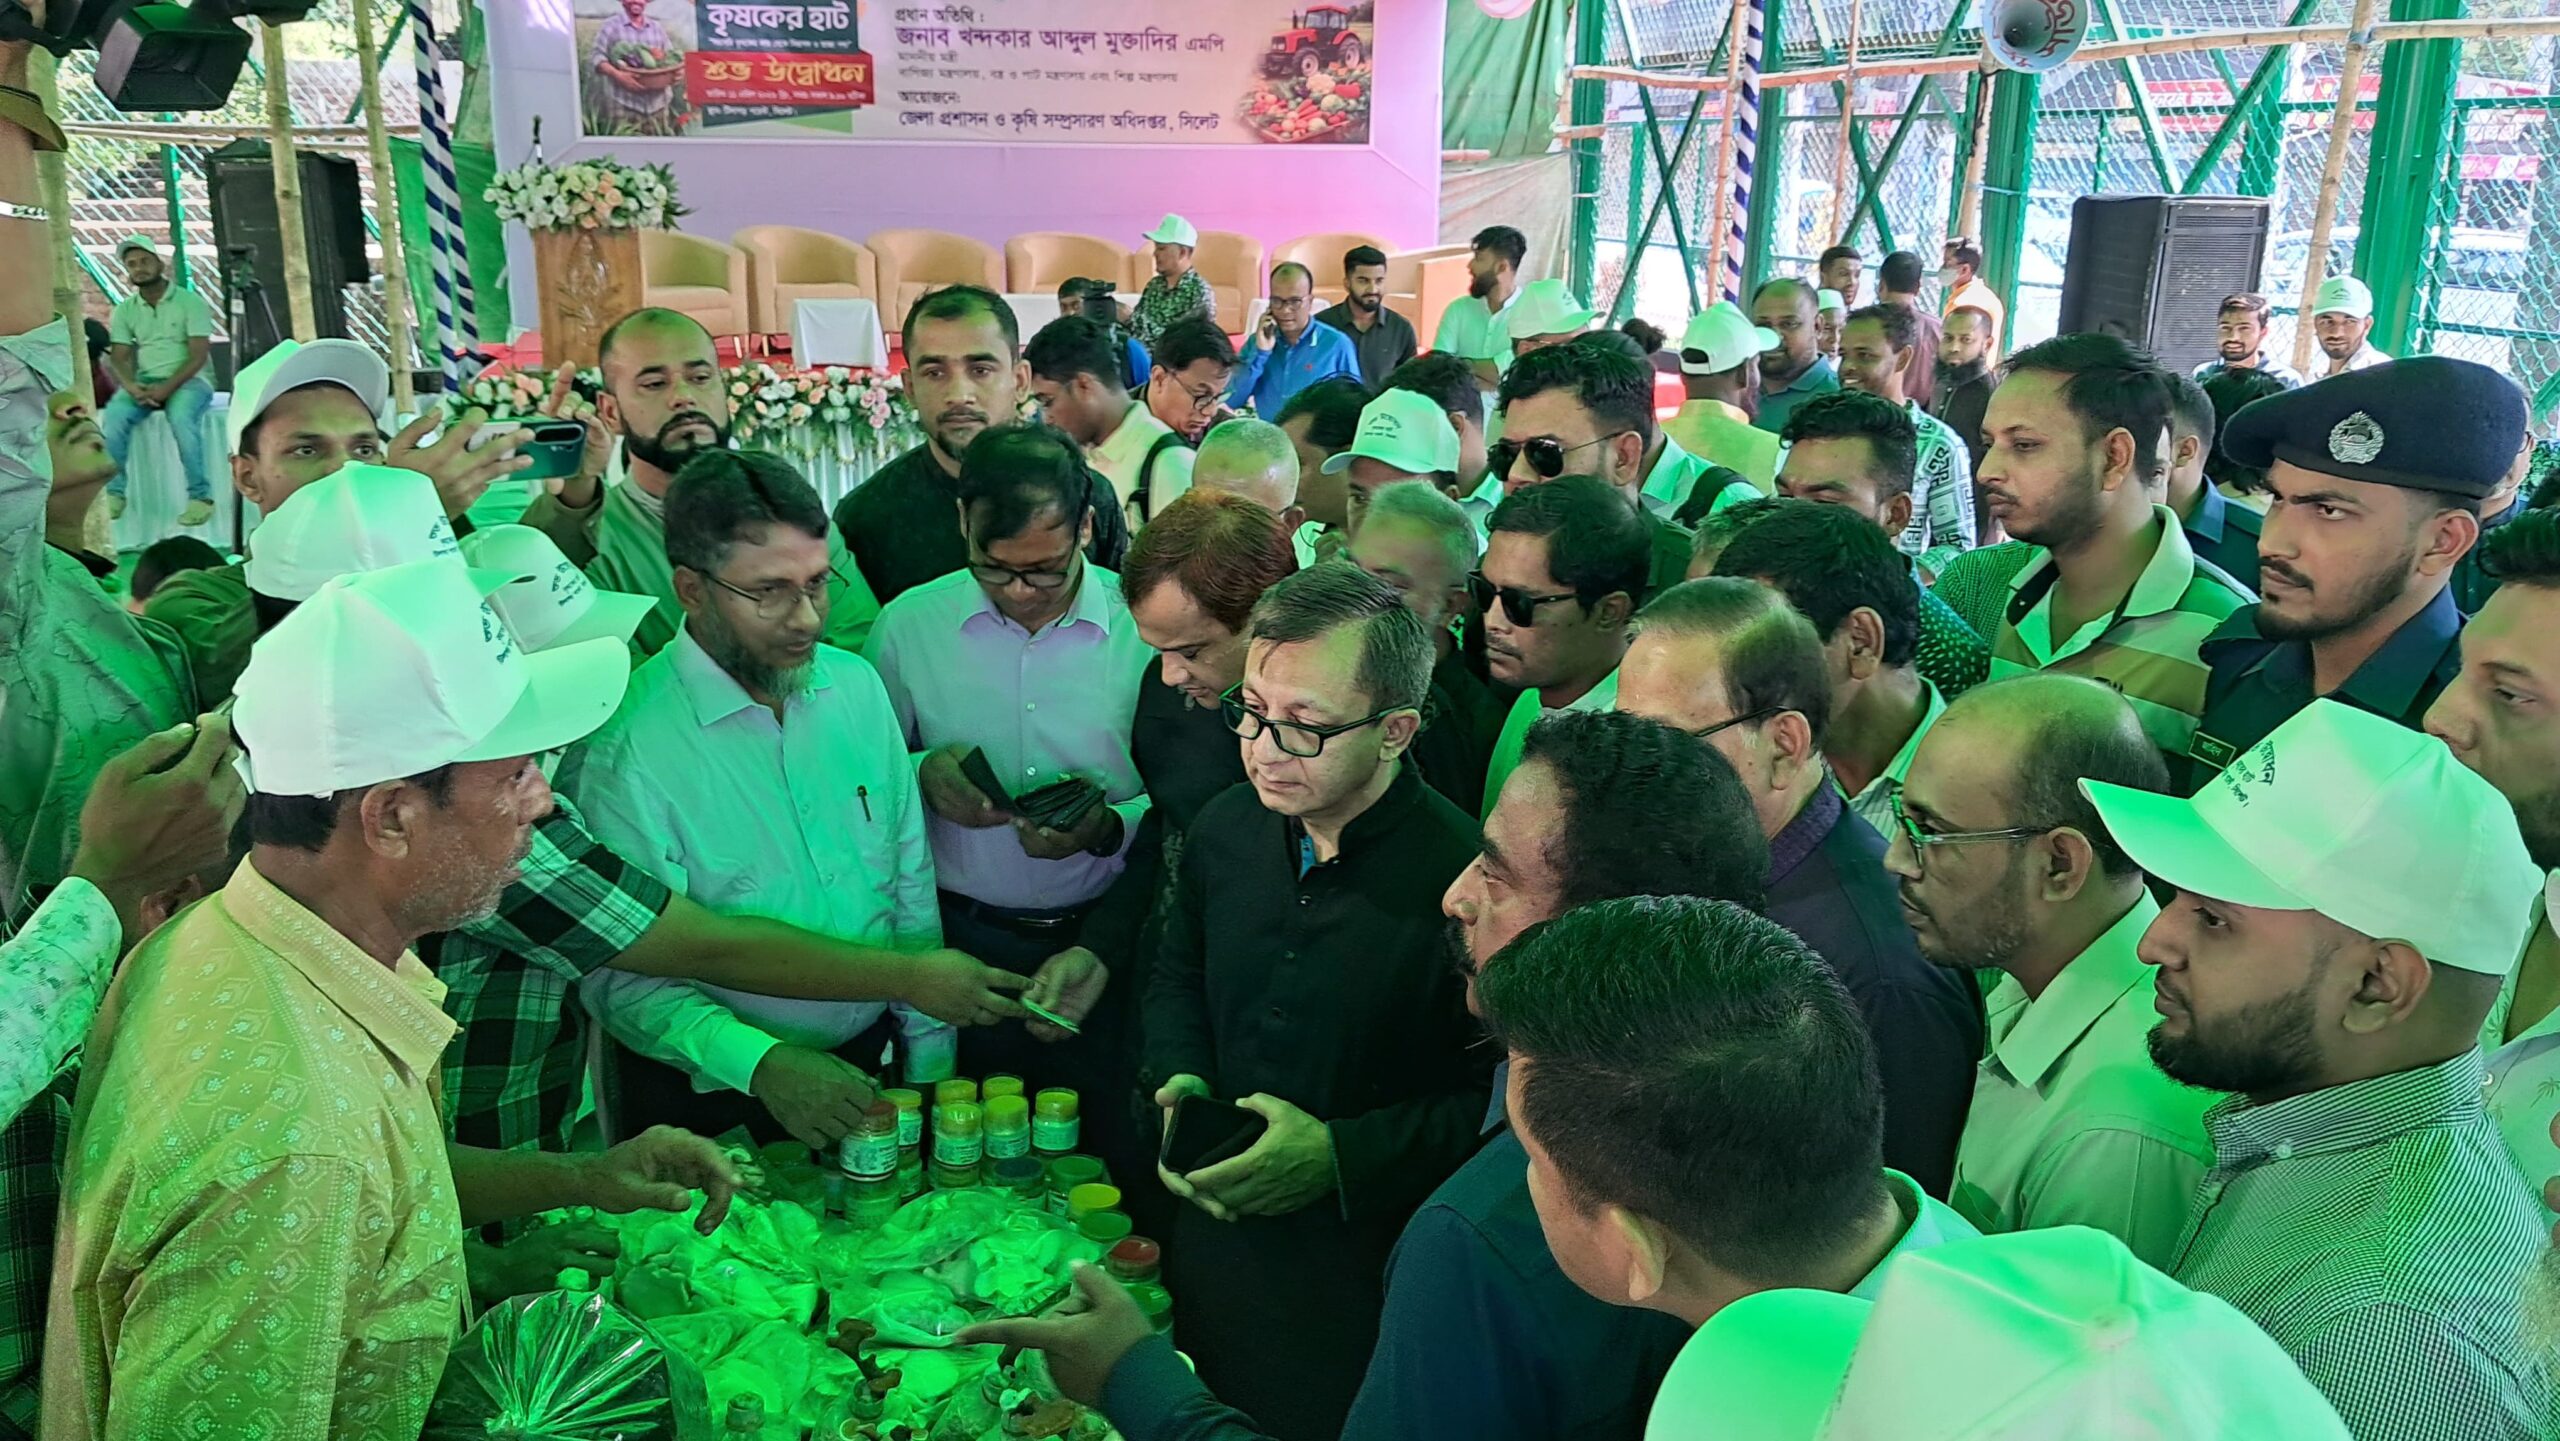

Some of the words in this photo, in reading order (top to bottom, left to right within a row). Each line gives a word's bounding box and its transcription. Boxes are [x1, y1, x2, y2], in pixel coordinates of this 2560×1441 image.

[706, 4, 803, 37] কৃষকের
[808, 0, 850, 31] হাট
[895, 8, 928, 22] প্রধান
[933, 5, 974, 23] অতিথি
[895, 27, 951, 47] জনাব
[959, 26, 1032, 48] খন্দকার
[1104, 26, 1179, 56] মুক্তাদির
[1185, 33, 1224, 52] এমপি
[702, 59, 754, 82] শুভ
[761, 54, 867, 86] উদ্বোধন
[899, 111, 935, 126] জেলা
[939, 112, 988, 127] প্রশাসন
[994, 113, 1006, 127] ও
[1010, 108, 1039, 133] কৃষি
[1042, 113, 1105, 130] সম্প্রসারণ
[1179, 110, 1220, 131] সিলেট
